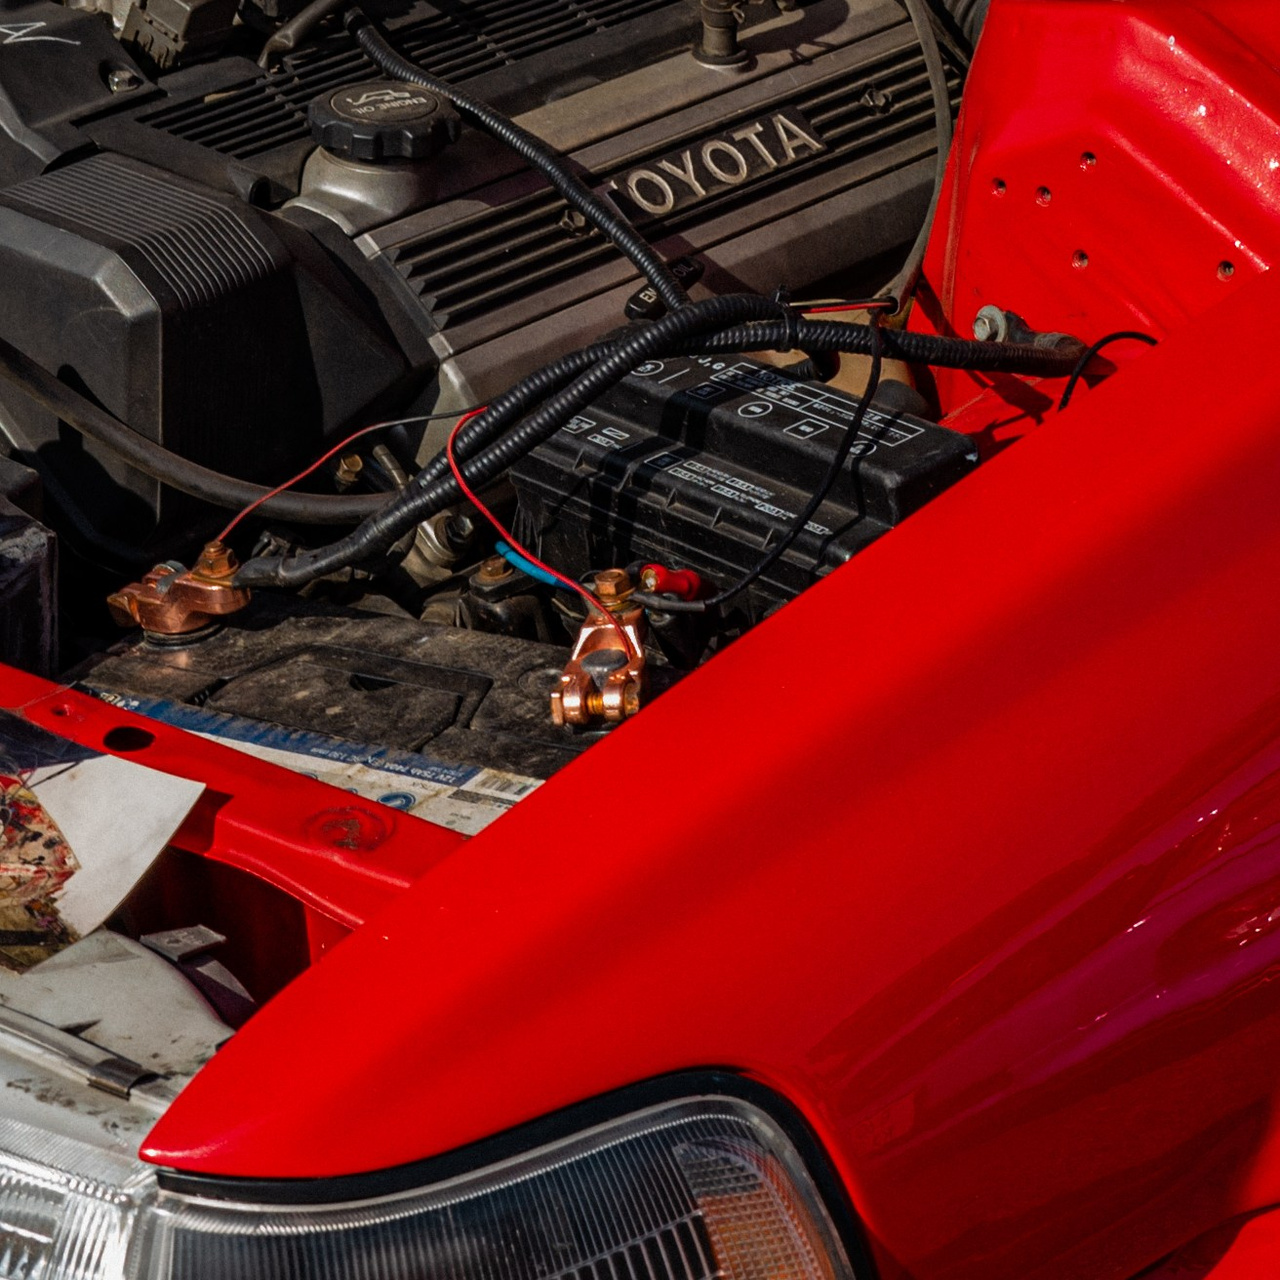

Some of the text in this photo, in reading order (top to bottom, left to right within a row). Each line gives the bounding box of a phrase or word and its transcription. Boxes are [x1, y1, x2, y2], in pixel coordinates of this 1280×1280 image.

[350, 96, 428, 114] ENGINE OIL
[611, 113, 823, 215] OYOTA
